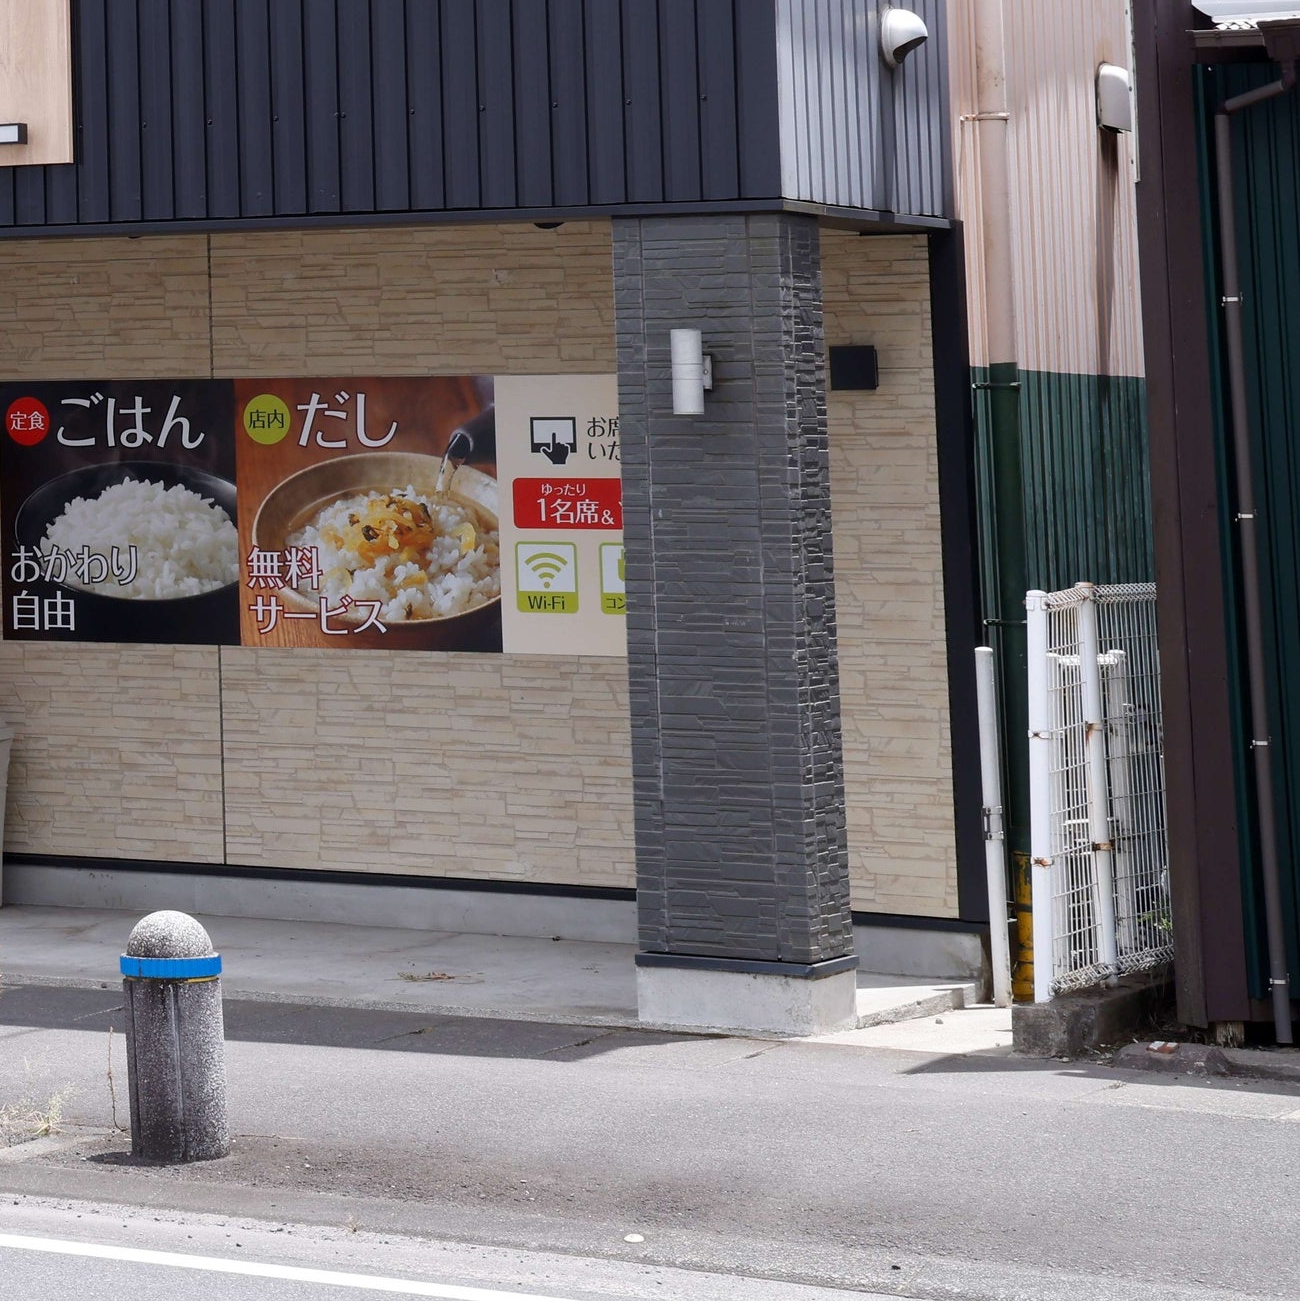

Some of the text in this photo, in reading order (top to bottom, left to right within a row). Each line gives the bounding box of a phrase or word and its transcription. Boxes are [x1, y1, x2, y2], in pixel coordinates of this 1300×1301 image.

[10, 392, 205, 449] 定食 ごはん
[248, 390, 398, 448] 店内 だし
[541, 483, 586, 497] ゆったり
[537, 498, 623, 525] 1名席&
[11, 544, 138, 585] おかわり
[246, 545, 324, 591] 無料
[12, 589, 76, 631] 自由
[249, 594, 388, 635] サービス
[527, 595, 566, 611] Wi-Fi
